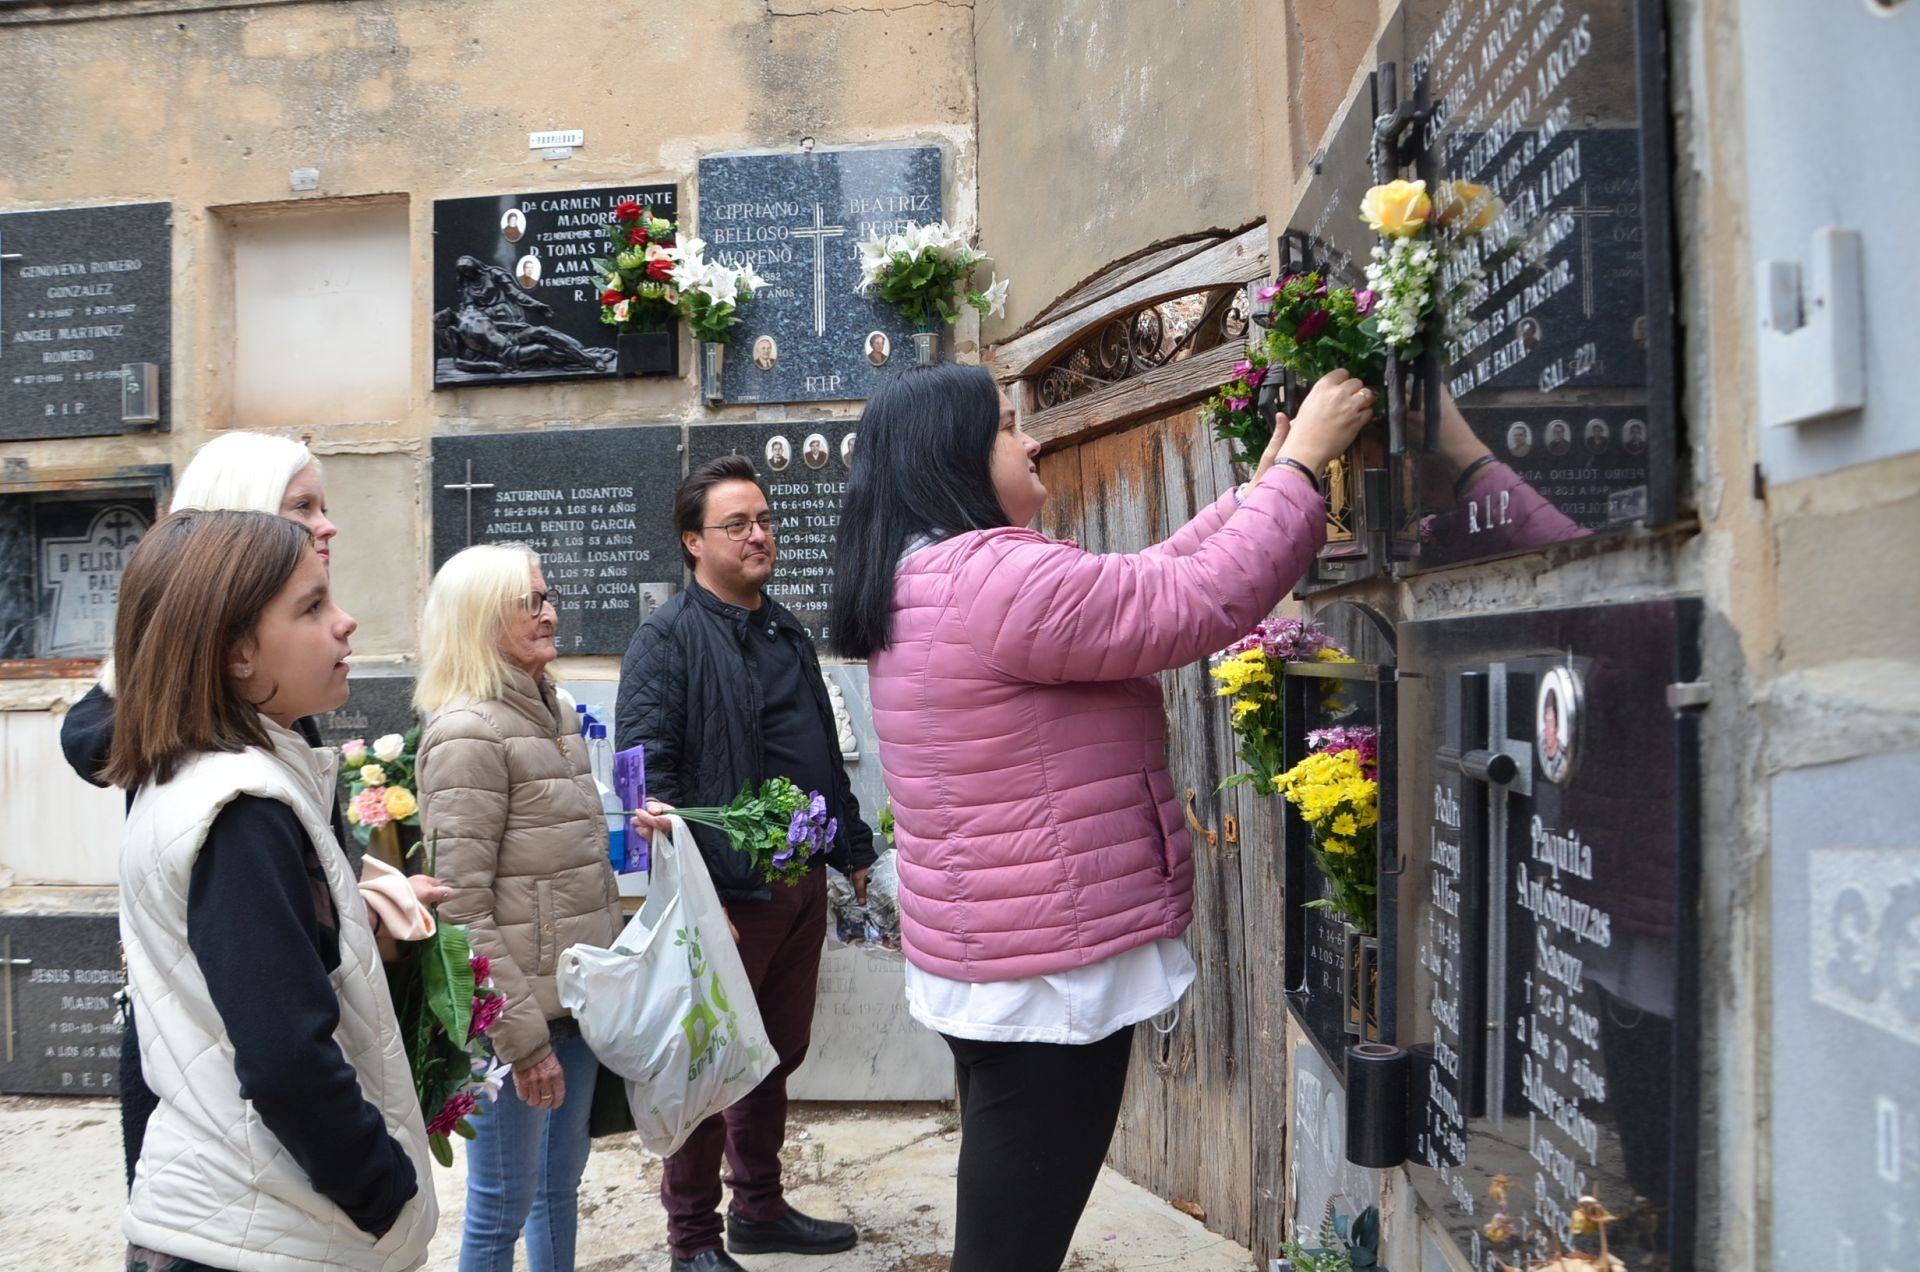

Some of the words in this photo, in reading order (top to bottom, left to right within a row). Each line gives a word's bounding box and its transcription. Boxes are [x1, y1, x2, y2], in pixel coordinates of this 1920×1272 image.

[1536, 14, 1591, 108] ARCOS
[1537, 97, 1570, 153] AÑOS
[1542, 139, 1581, 208] LURI
[541, 197, 600, 211] CARMEN
[717, 201, 799, 220] CIPRIANO
[850, 194, 930, 214] BEATRIZ
[715, 226, 789, 244] BELLOSO
[546, 243, 596, 256] TOMAS
[718, 249, 792, 267] MORENO
[90, 259, 142, 274] ROMERO
[47, 283, 113, 298] GONZALEZ
[767, 287, 795, 299] AÑOS
[1491, 308, 1505, 337] ES
[1507, 294, 1521, 326] MI
[13, 329, 53, 342] ANGEL
[57, 326, 124, 339] MARTINEZ
[43, 349, 94, 363] ROMERO
[1450, 369, 1475, 400] NADA
[1477, 357, 1491, 386] ME
[496, 489, 564, 503] SATURNINA
[571, 487, 633, 500] LOSANTOS
[770, 484, 809, 496] PEDRO
[555, 505, 562, 515] A
[568, 504, 586, 515] LOS
[608, 502, 636, 514] AÑOS
[781, 500, 824, 510] 6-6-1949
[486, 523, 533, 534] ANGELA
[541, 520, 584, 532] BENITO
[591, 518, 636, 530] GARCIA
[565, 537, 584, 546] LOS
[606, 535, 633, 545] AÑOS
[779, 534, 826, 544] 10-9-1962
[79, 552, 123, 572] ELISA
[537, 552, 580, 564] TOBAL
[588, 550, 650, 562] LOSANTOS
[547, 569, 555, 578] A
[560, 568, 578, 578] LOS
[600, 566, 628, 577] AÑOS
[774, 567, 824, 577] 20-4-1969
[597, 583, 636, 594] OCHOA
[766, 584, 814, 596] FERMIN
[562, 600, 580, 610] LOS
[602, 598, 630, 609] AÑOS
[1530, 814, 1592, 879] Paquita
[1319, 947, 1333, 965] LOS
[29, 969, 70, 984] JESUS
[61, 996, 110, 1010] MARIN
[57, 1046, 79, 1057] LOS
